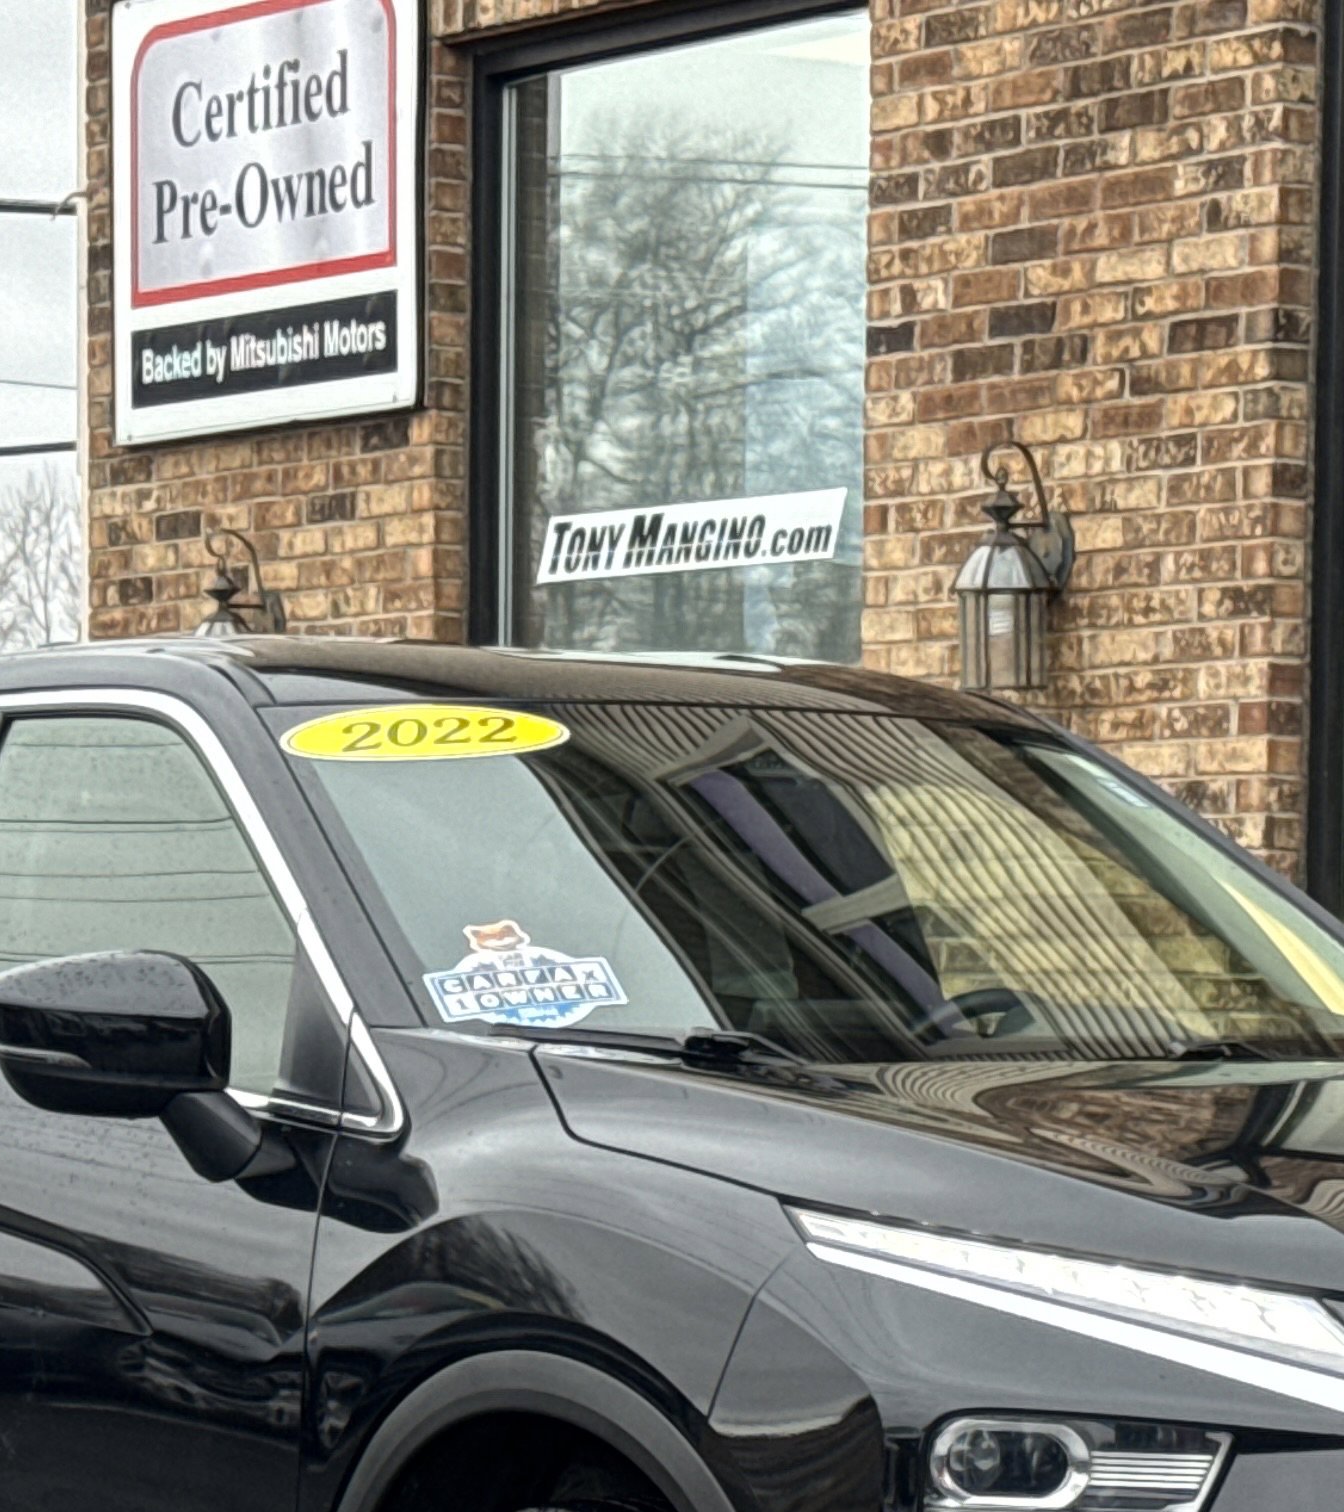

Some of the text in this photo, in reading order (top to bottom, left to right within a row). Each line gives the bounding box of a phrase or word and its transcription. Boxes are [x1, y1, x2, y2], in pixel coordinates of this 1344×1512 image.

[172, 49, 350, 147] Certified
[152, 139, 376, 244] Pre-Owned
[141, 318, 387, 384] Backed by Mitsubishi Motors
[341, 716, 517, 752] 2022
[442, 966, 600, 994] CARFAX
[478, 984, 613, 1009] OWNER
